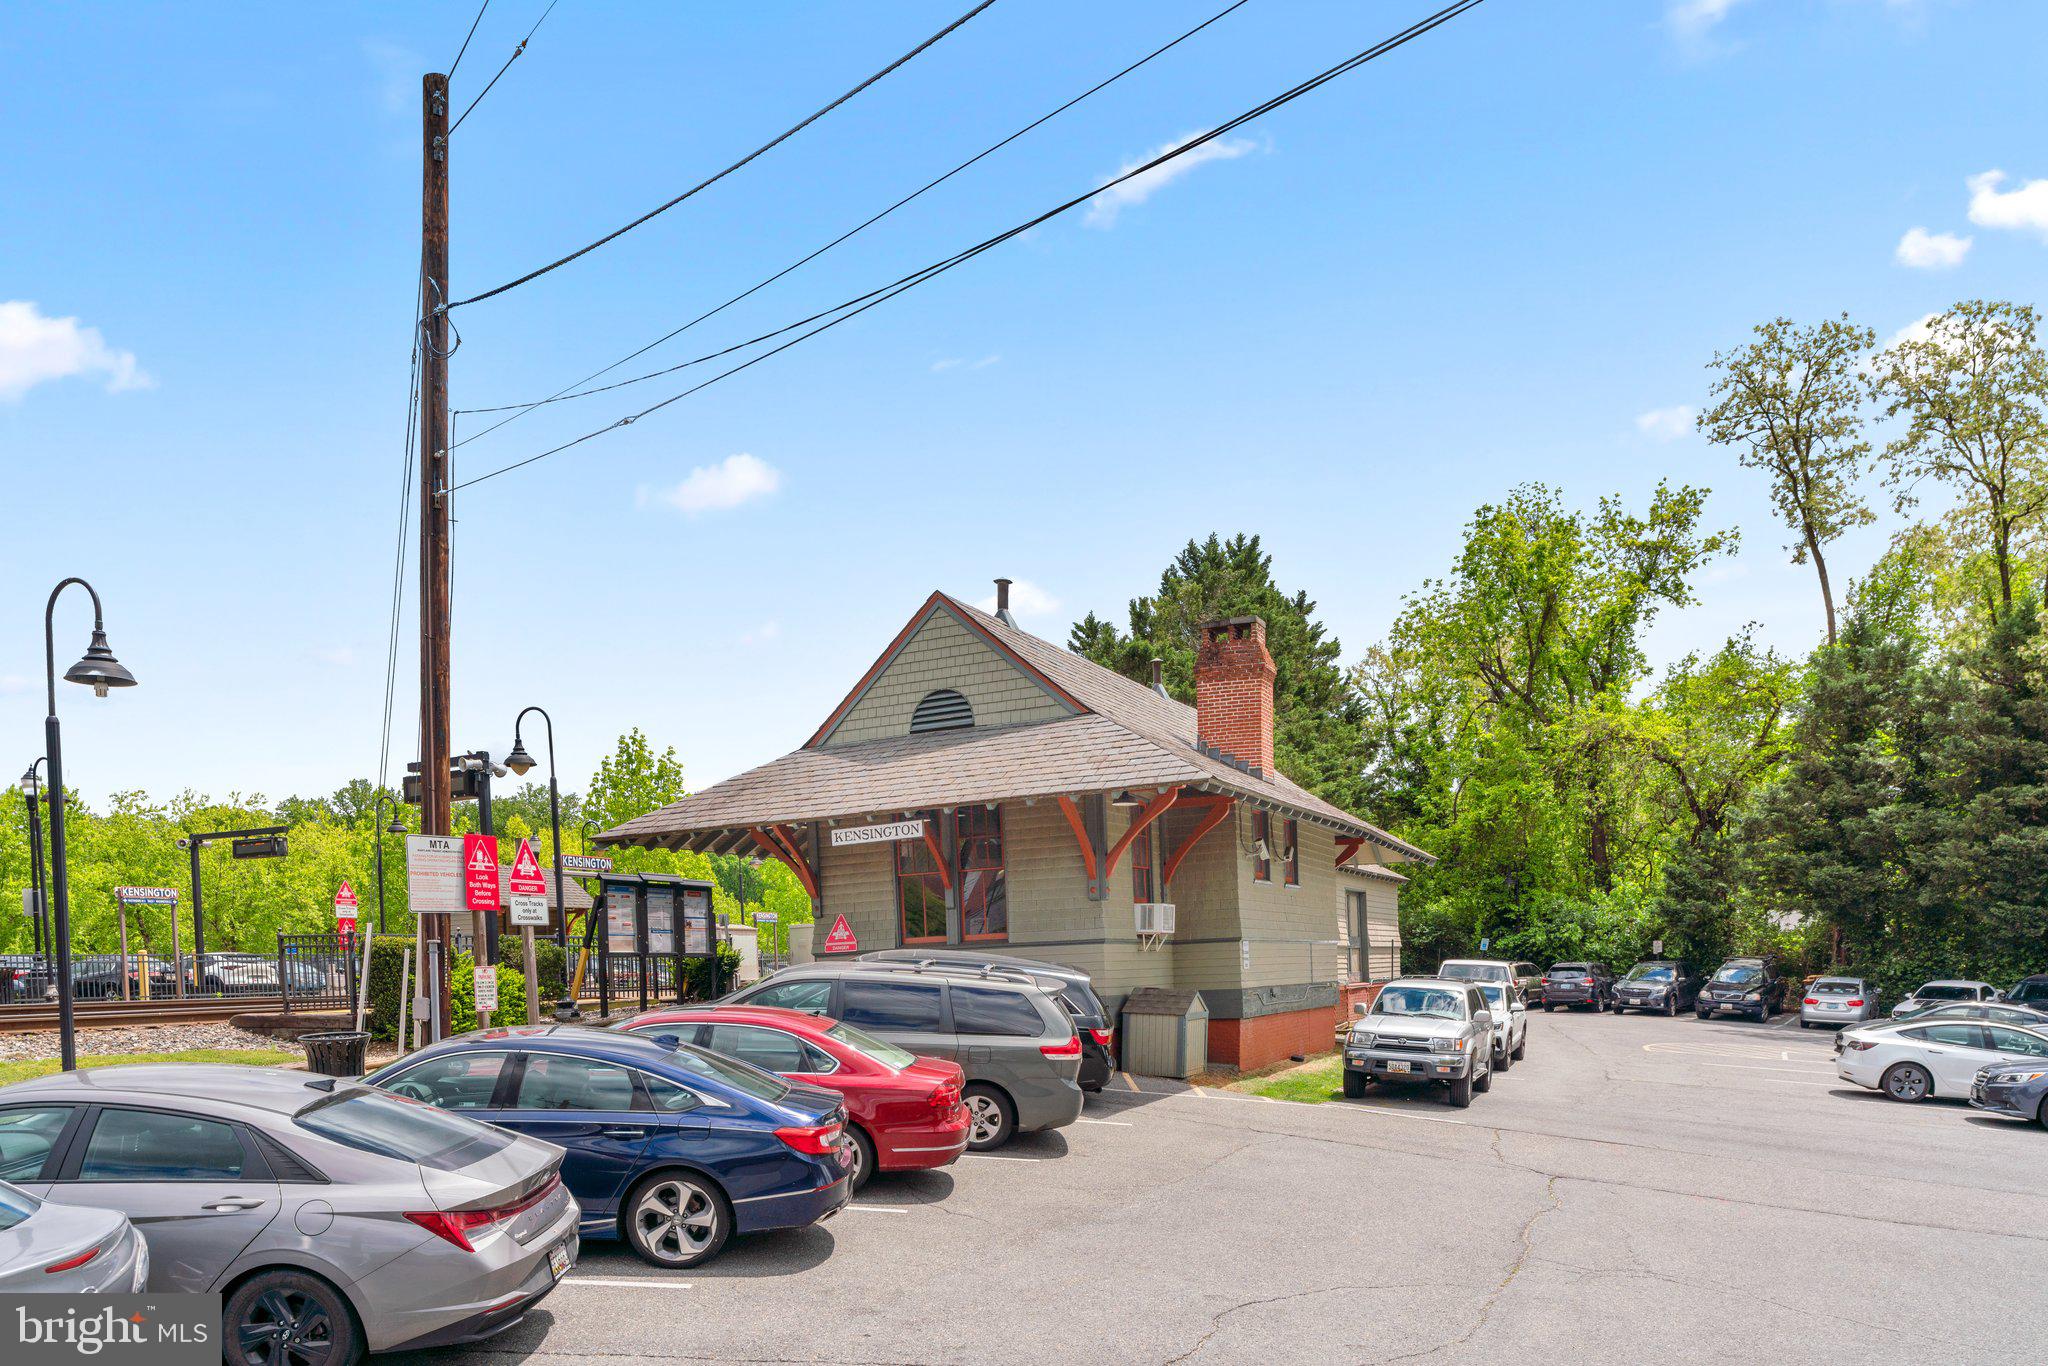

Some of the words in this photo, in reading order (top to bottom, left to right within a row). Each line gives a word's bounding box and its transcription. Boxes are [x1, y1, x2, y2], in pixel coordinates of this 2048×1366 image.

[834, 823, 920, 843] KENSINGTON
[429, 840, 450, 850] MTA
[562, 856, 612, 870] KENSINGTON
[122, 888, 177, 897] KENSINGTON
[472, 898, 495, 907] Crossing
